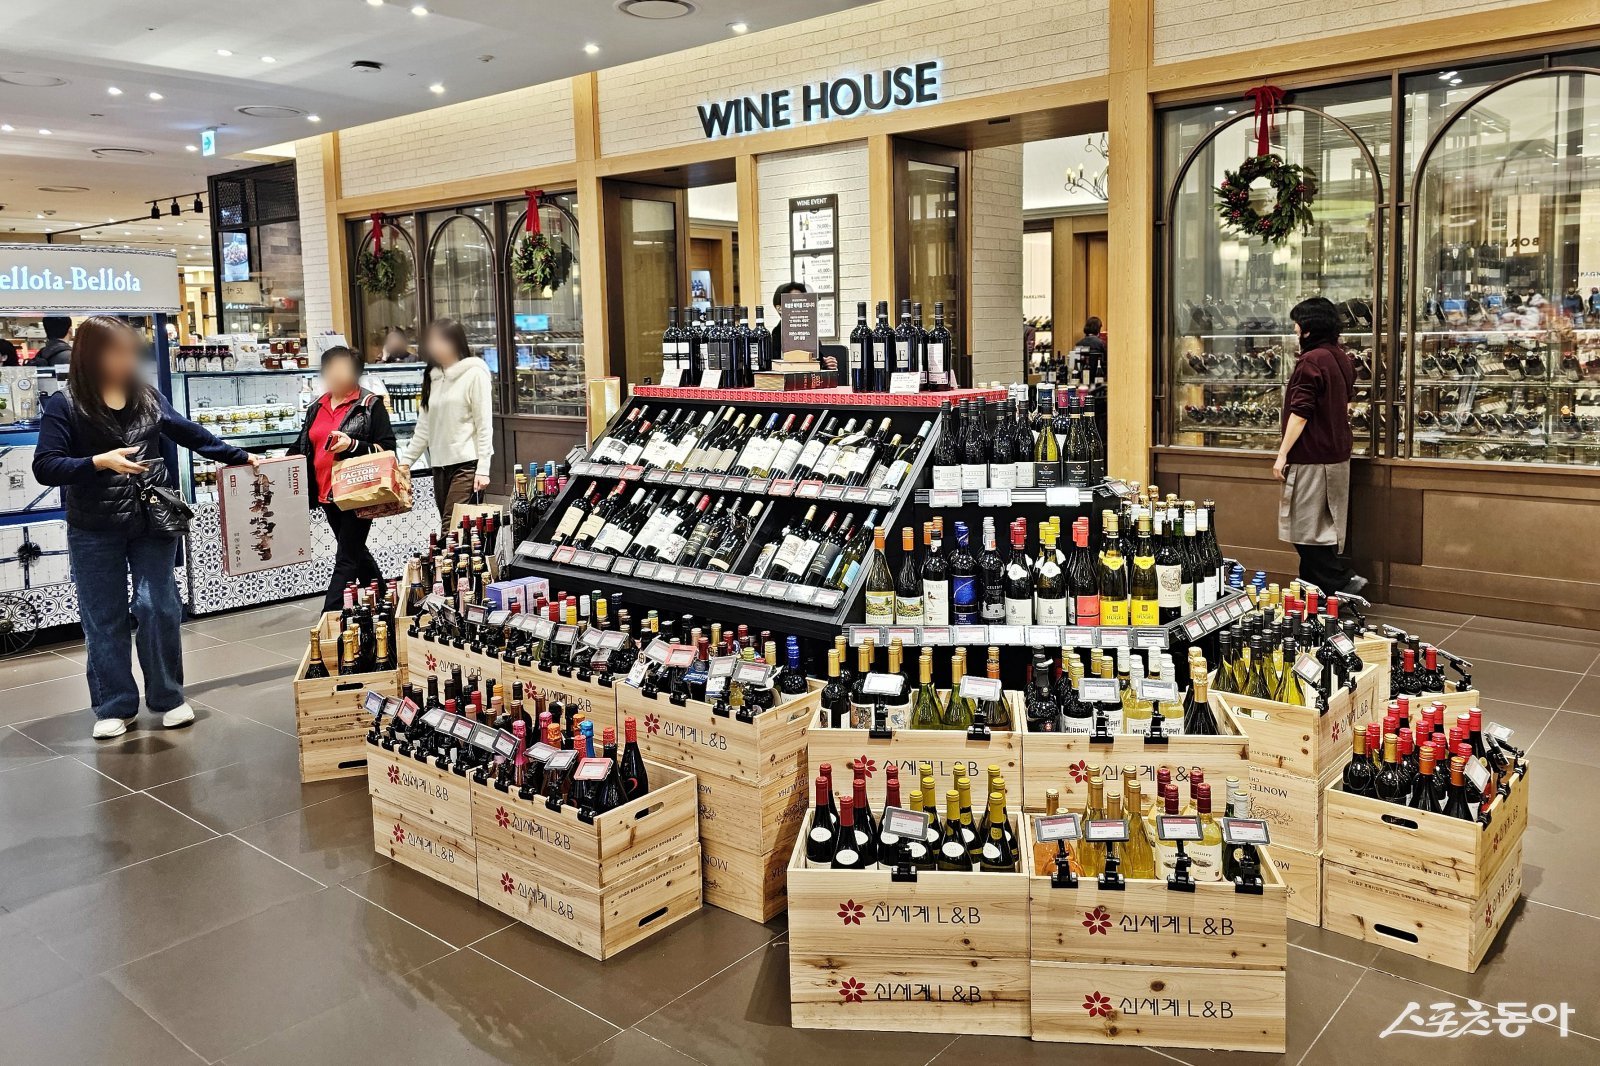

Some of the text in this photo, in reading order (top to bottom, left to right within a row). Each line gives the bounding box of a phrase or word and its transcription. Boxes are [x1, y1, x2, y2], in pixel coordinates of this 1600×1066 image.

[697, 61, 937, 138] WINE HOUSE
[340, 466, 380, 481] FACTORY
[347, 473, 375, 485] STORE
[664, 721, 727, 750] 신세계 L&B
[1102, 765, 1155, 781] 신계
[402, 773, 449, 801] 신세계 L&B
[408, 832, 455, 864] 신세계 L&B
[547, 828, 571, 850] L&B
[551, 897, 575, 920] L&B
[872, 905, 981, 924] 신세계 L&B
[1119, 915, 1234, 936] 신세계 L&B
[874, 983, 982, 1003] 신세계 L&B
[1119, 998, 1233, 1019] 신세계 L&B
